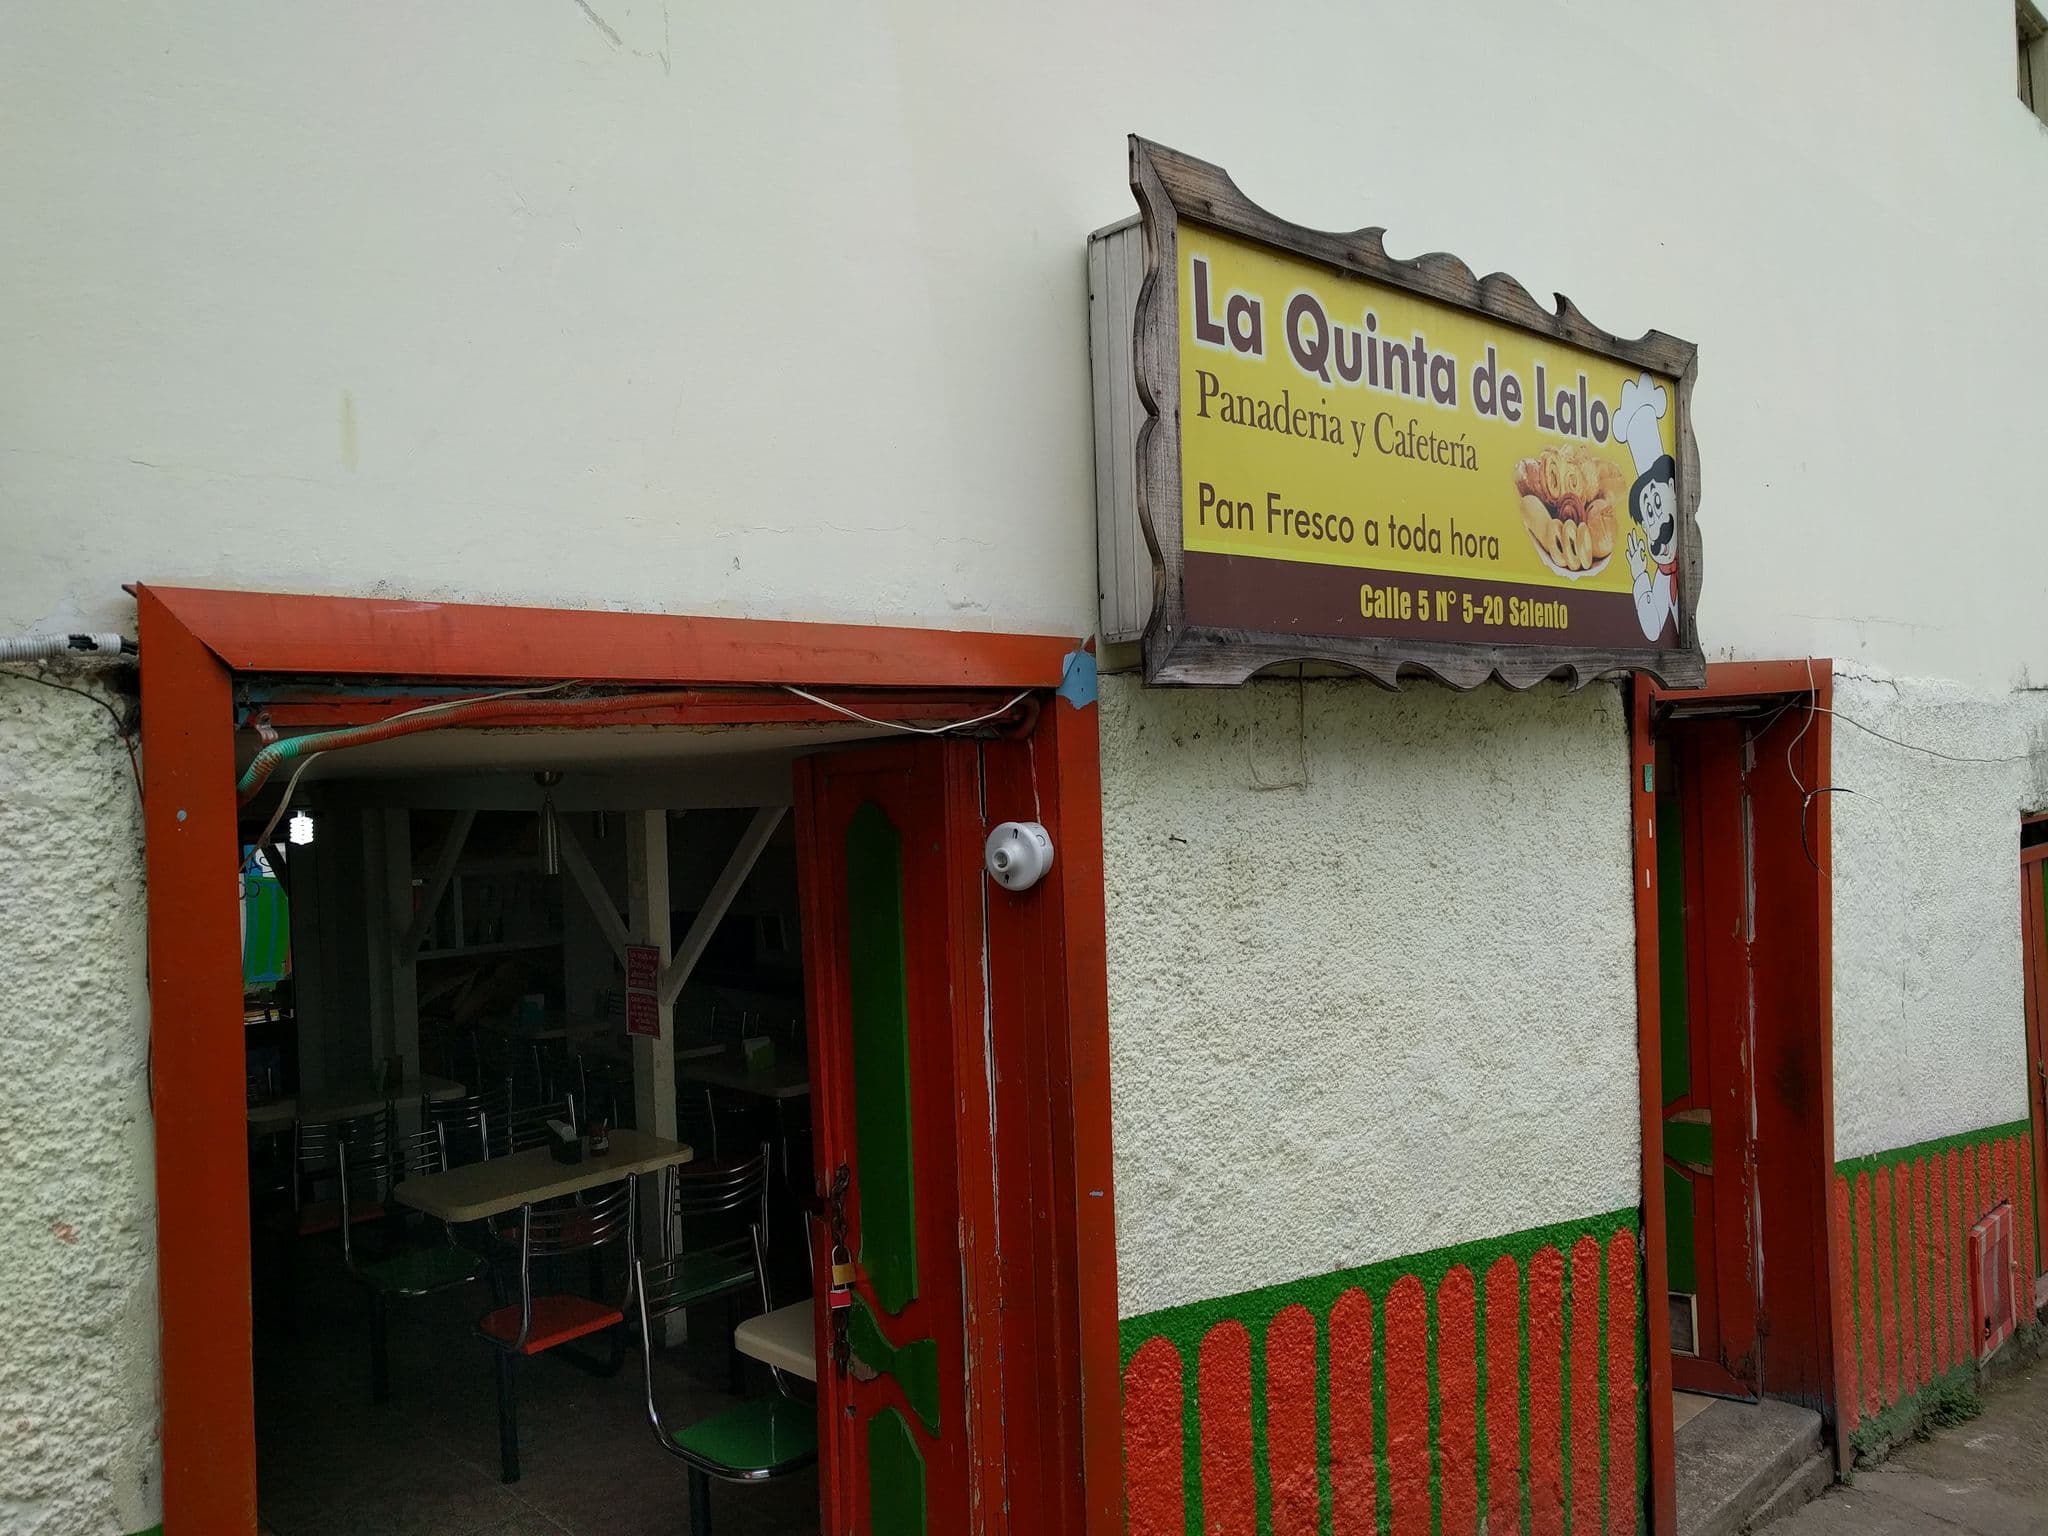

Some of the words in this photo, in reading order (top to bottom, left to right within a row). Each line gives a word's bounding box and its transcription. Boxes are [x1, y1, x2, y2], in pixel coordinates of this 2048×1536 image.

[1193, 258, 1263, 356] La
[1286, 293, 1457, 406] Quinta
[1472, 346, 1523, 422] de
[1535, 365, 1610, 444] Lalo
[1195, 369, 1345, 445] Panaderia
[1350, 419, 1366, 458] y
[1373, 411, 1479, 472] Cafetería
[1198, 482, 1255, 532] Pan
[1266, 491, 1355, 544] Fresco
[1363, 518, 1379, 547] a
[1387, 513, 1442, 554] toda
[1450, 517, 1500, 561] hora
[1359, 583, 1412, 621] Calle
[1417, 589, 1430, 622] 5
[1462, 593, 1505, 626] 5-20
[1508, 596, 1568, 630] Salento
